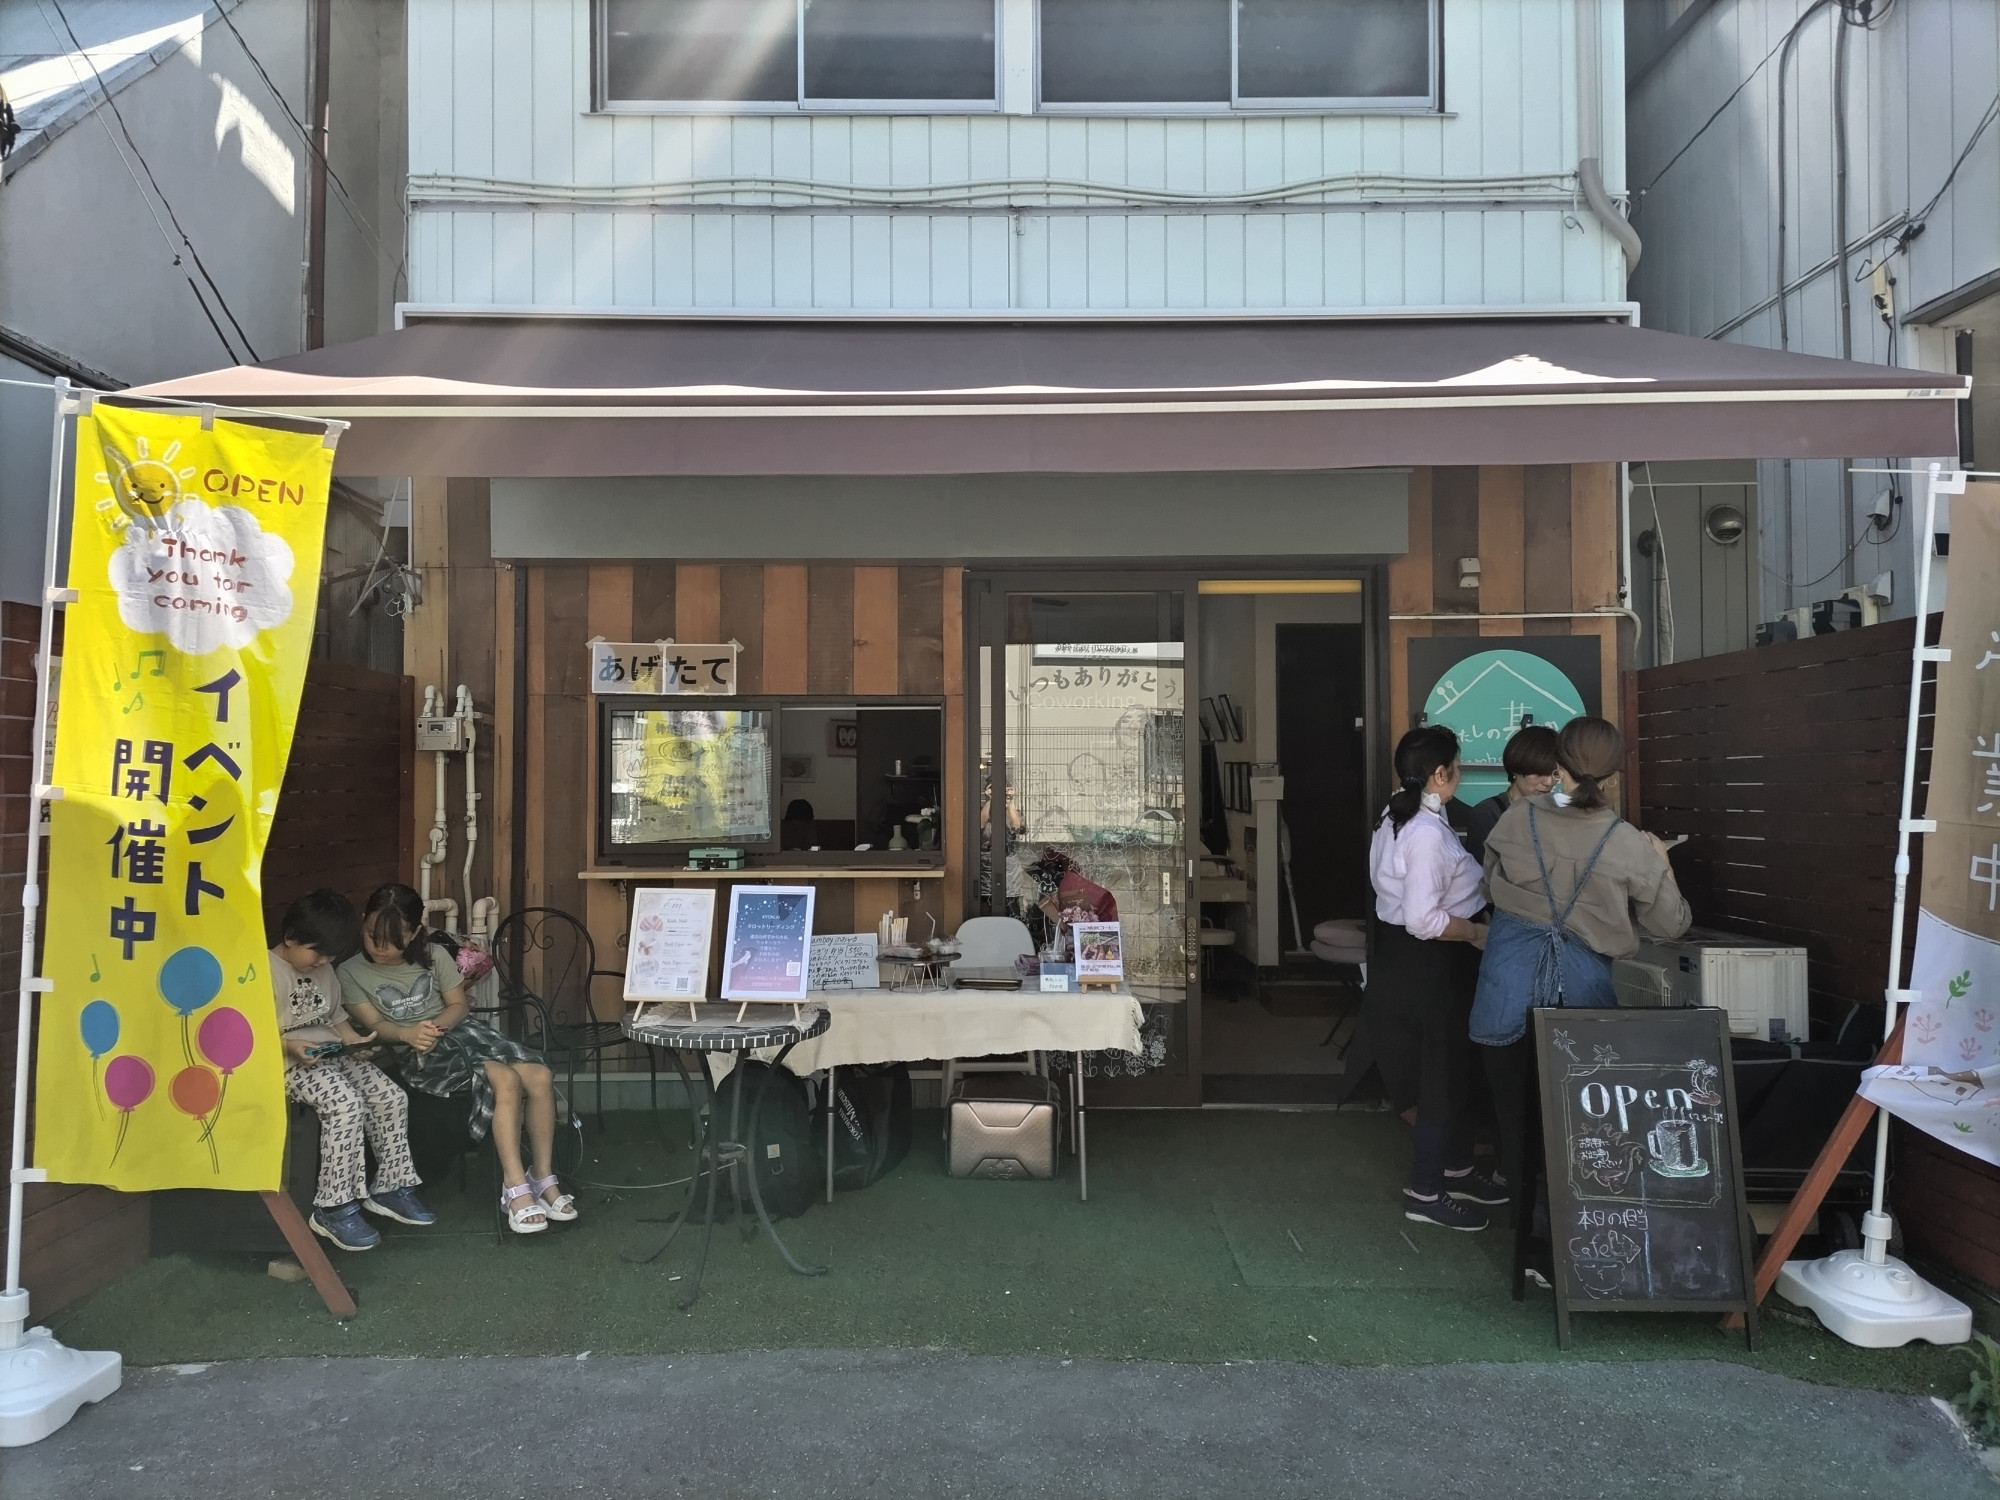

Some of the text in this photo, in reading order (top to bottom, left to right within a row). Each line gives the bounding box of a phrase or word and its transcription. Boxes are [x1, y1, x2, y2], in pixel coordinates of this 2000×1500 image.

[203, 468, 304, 506] OPEN
[161, 538, 248, 568] Thank
[146, 567, 254, 592] you for
[153, 595, 248, 622] coming
[598, 655, 731, 685] あげたて
[182, 668, 243, 916] イベント
[105, 738, 174, 961] 開催中
[1578, 1205, 1649, 1232] 本日の担当
